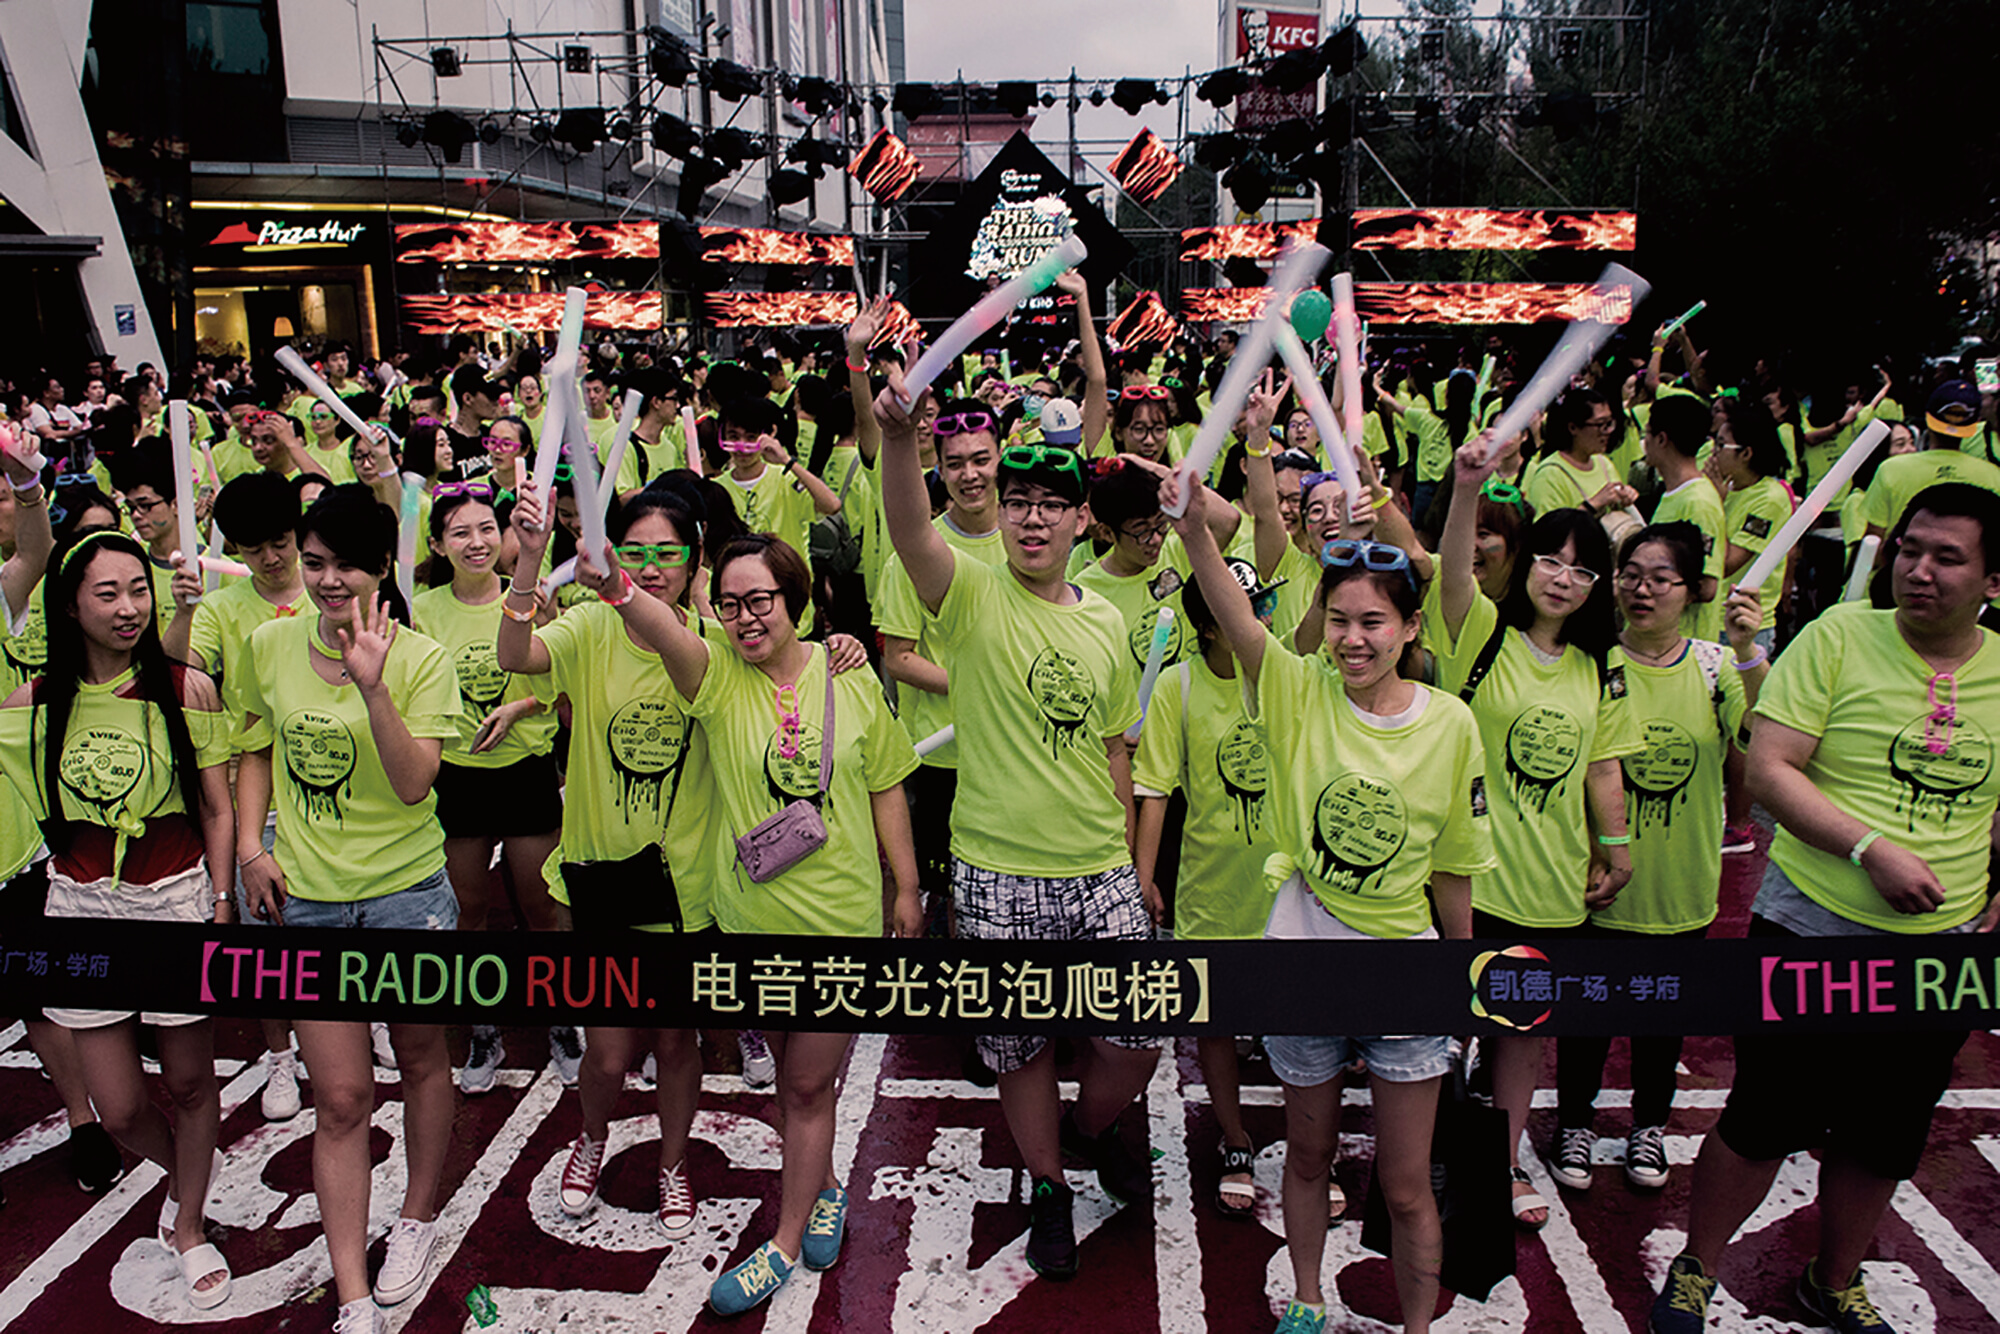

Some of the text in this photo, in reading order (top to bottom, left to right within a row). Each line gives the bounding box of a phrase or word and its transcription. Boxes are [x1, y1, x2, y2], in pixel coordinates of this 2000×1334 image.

[1272, 25, 1316, 47] KFC
[985, 222, 1056, 239] RADIO
[991, 210, 1034, 226] THE
[257, 219, 366, 246] Pizza Hut
[0, 945, 110, 978] 广场·学府
[338, 950, 509, 1006] RADIO
[526, 956, 657, 1009] RUN.
[1914, 957, 2000, 1011] RA
